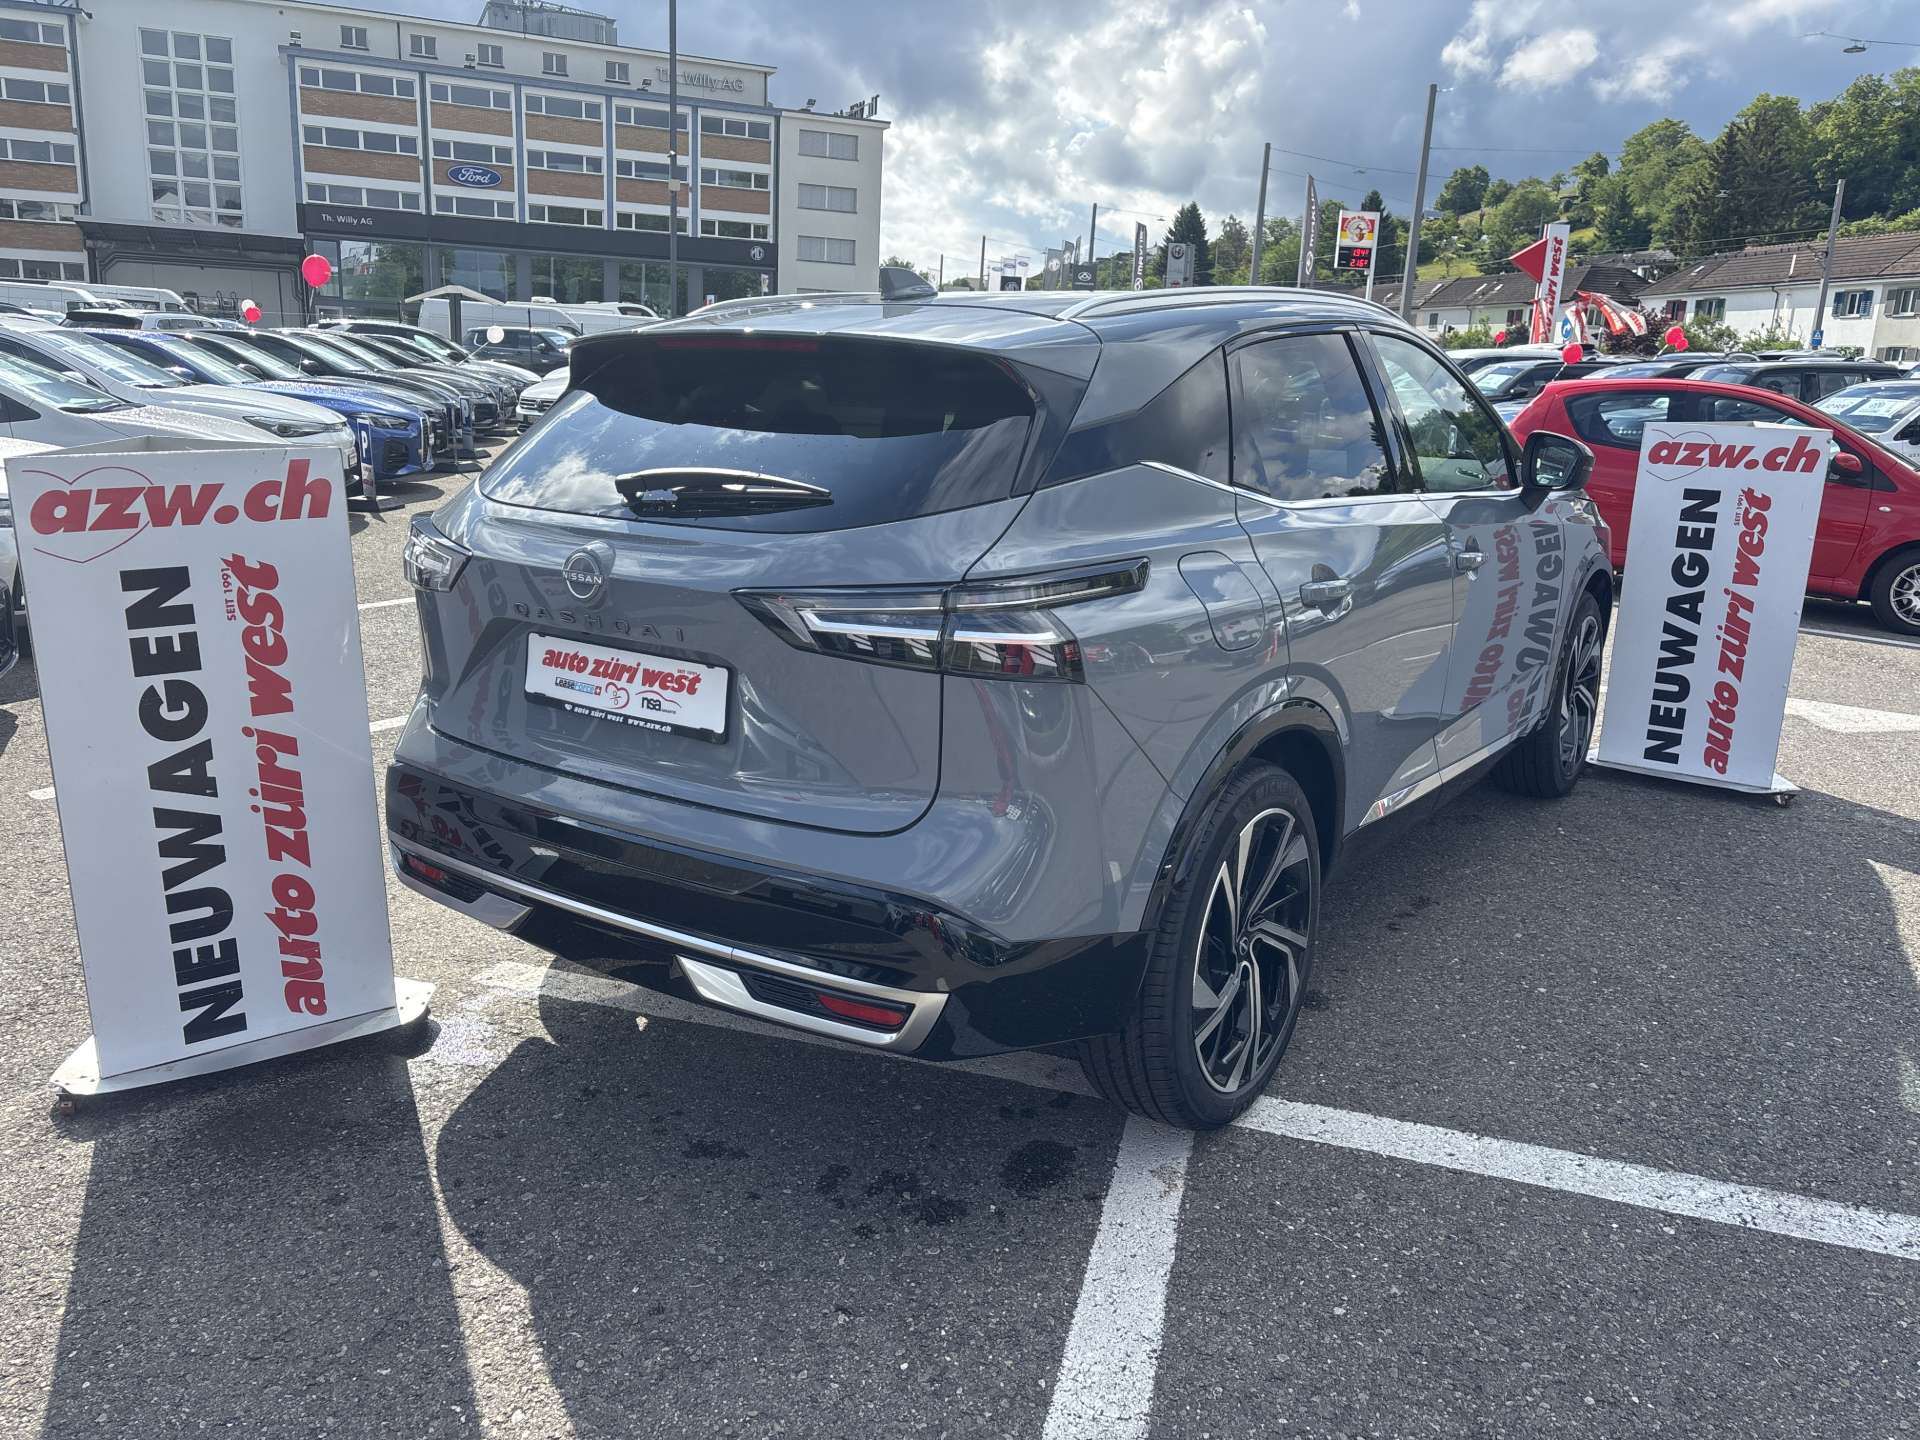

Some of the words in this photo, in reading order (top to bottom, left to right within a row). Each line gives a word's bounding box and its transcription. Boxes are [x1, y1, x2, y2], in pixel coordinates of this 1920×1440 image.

[684, 71, 718, 92] Willy
[722, 78, 745, 92] AG
[458, 167, 492, 183] Ford
[321, 213, 334, 222] Th.
[336, 215, 358, 226] Willy
[360, 217, 373, 225] AG
[361, 430, 368, 458] P
[1647, 436, 1821, 473] azw.ch
[30, 458, 332, 533] azw.ch
[1732, 487, 1772, 586] west
[221, 567, 233, 594] 1991
[562, 570, 603, 584] NISSAN
[225, 598, 237, 622] SEIT
[513, 601, 685, 642] QASHQAI
[1643, 487, 1722, 765] NEUWAGEN
[220, 553, 294, 716] west
[1715, 588, 1755, 684] züri
[542, 648, 590, 674] auto
[588, 656, 641, 684] züri
[641, 667, 702, 695] west
[573, 706, 589, 715] auto
[607, 713, 624, 723] west
[627, 717, 672, 733] www.azw.ch
[641, 696, 662, 711] nsa
[1704, 681, 1740, 775] auto
[119, 565, 249, 1046] NEUWAGEN
[241, 725, 312, 869] züri
[264, 873, 328, 1017] auto
